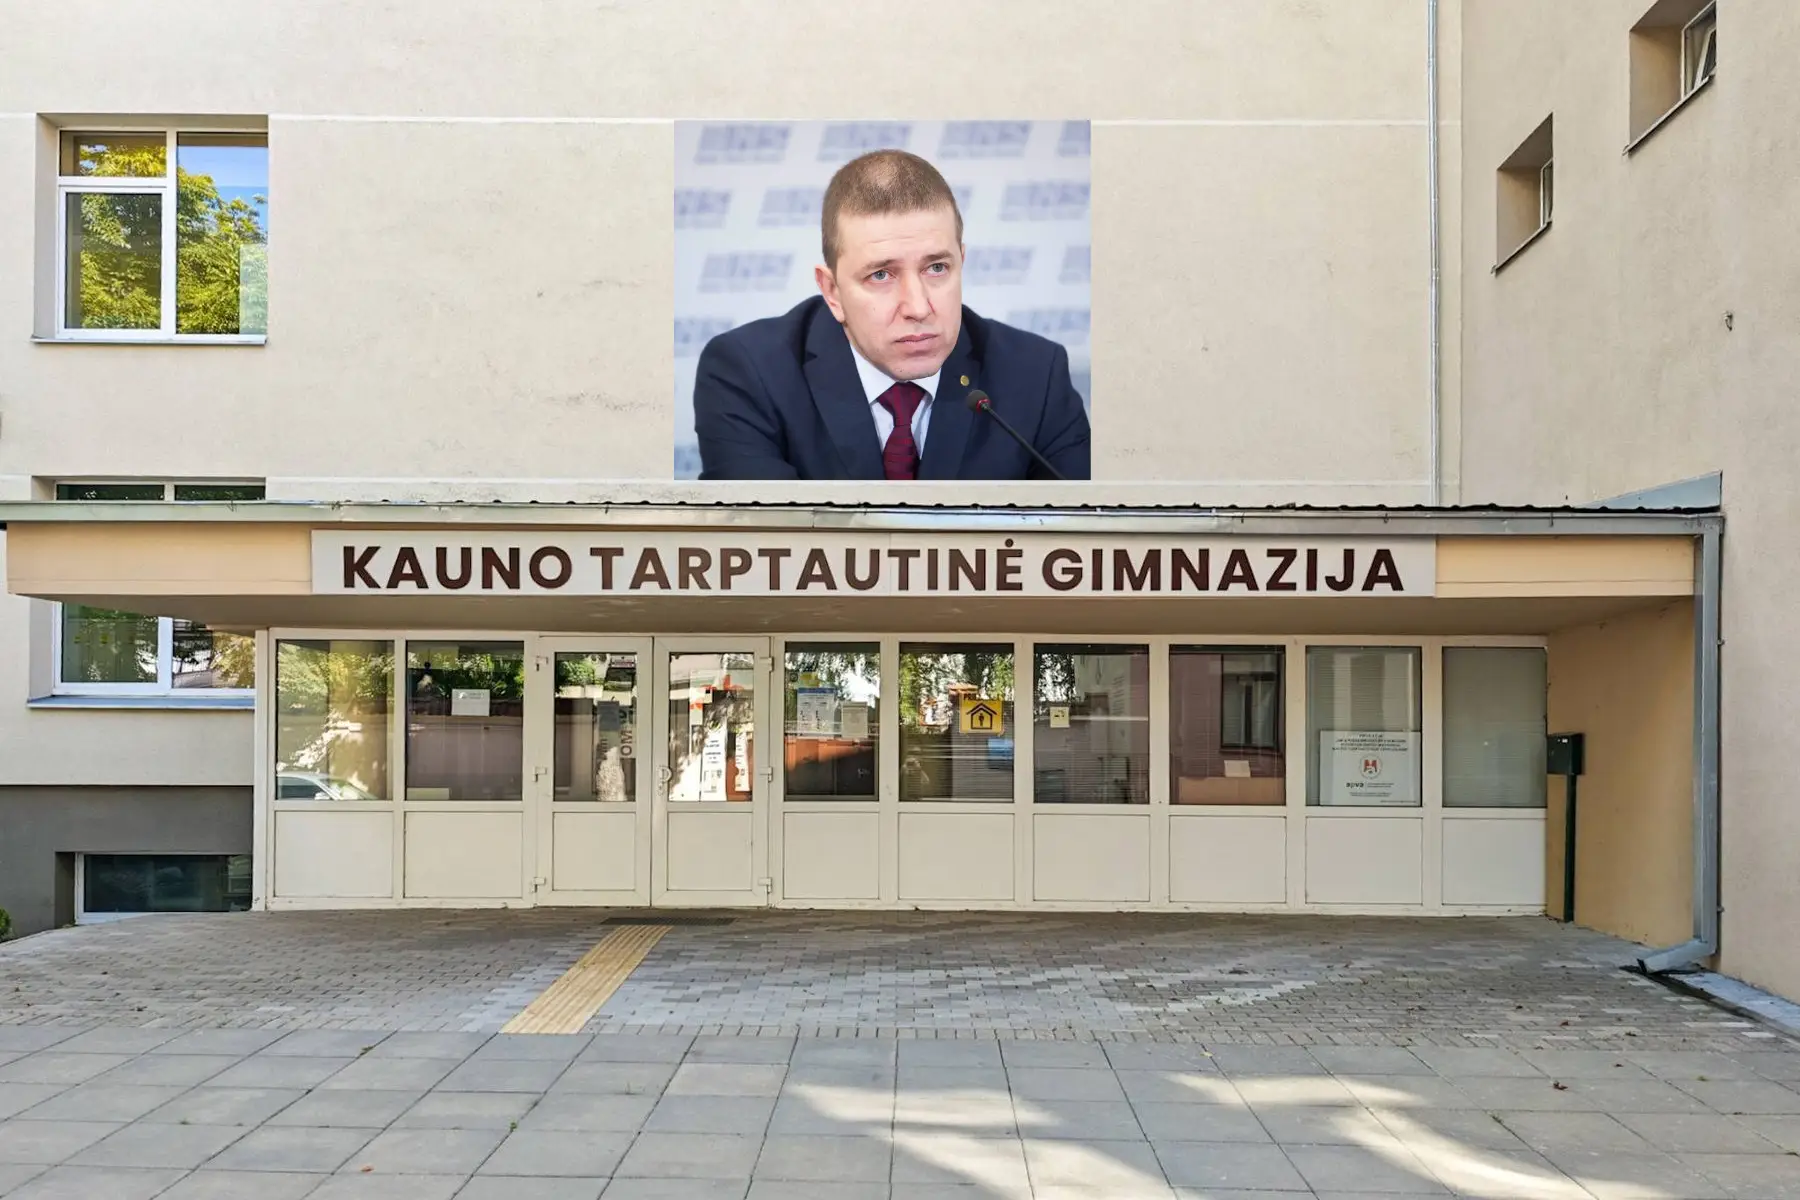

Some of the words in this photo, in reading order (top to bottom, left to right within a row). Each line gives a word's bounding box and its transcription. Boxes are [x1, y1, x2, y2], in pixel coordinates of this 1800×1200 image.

[343, 545, 573, 590] KAUNO
[589, 538, 1024, 592] TARPTAUTINĖ
[1041, 547, 1405, 593] GIMNAZIJA
